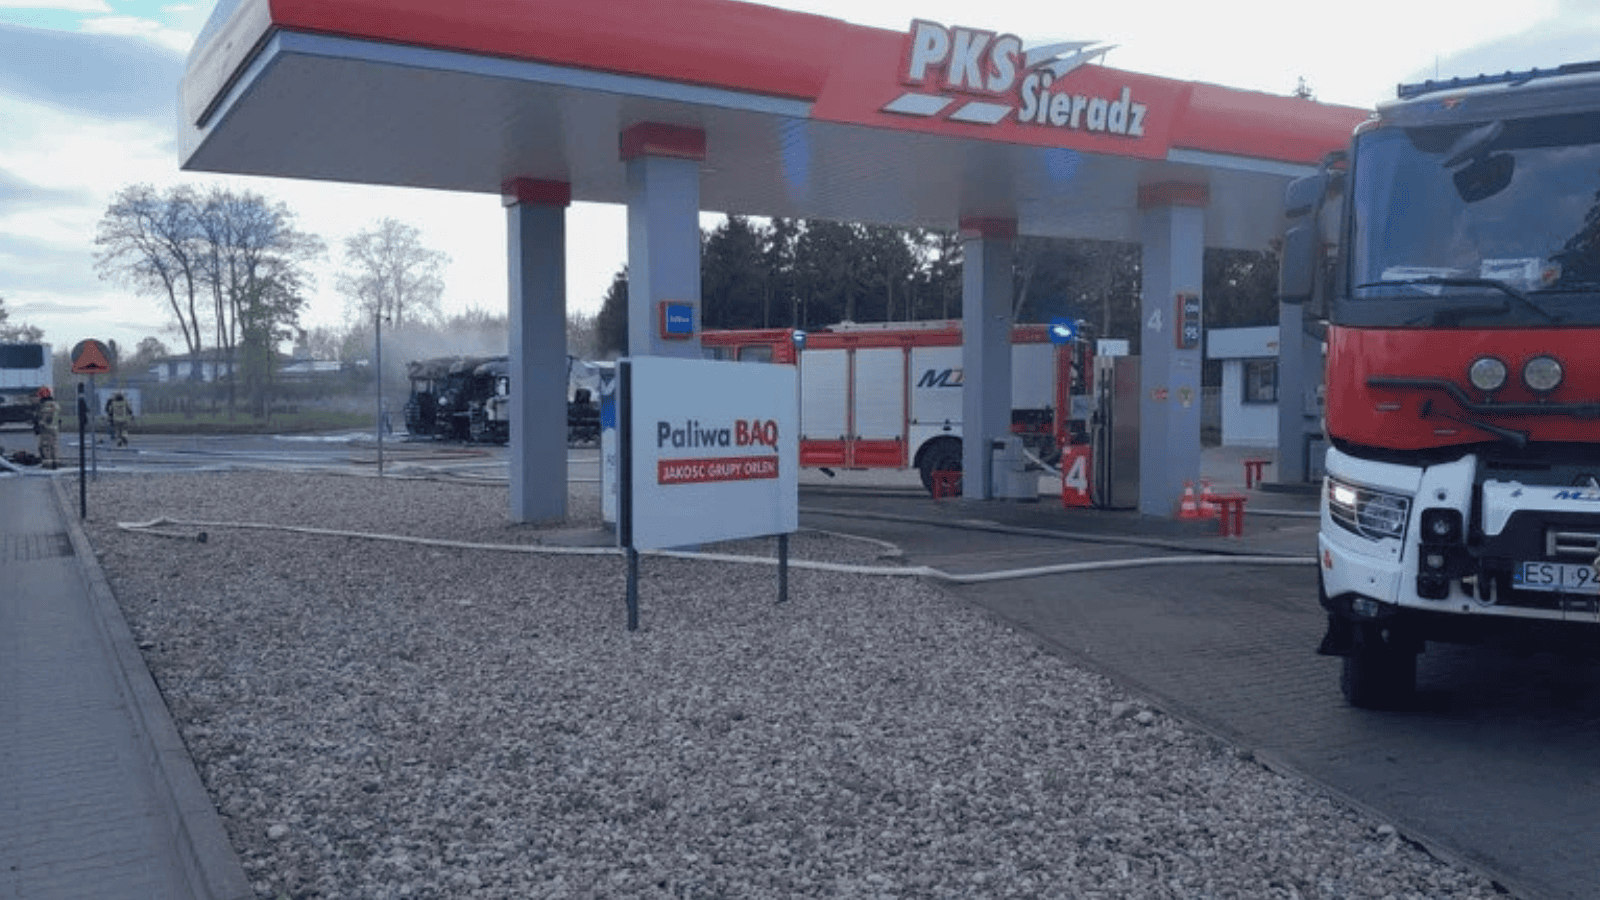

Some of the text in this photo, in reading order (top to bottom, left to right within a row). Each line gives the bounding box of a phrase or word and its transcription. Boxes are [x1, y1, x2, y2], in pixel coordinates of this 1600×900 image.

[909, 21, 1021, 92] PKS
[1018, 72, 1147, 136] Sieradz
[1147, 308, 1162, 332] 4
[657, 419, 778, 453] Paliwa BAQ
[708, 463, 742, 477] GRUPY
[744, 461, 775, 475] ORLEN
[1066, 455, 1088, 495] 4
